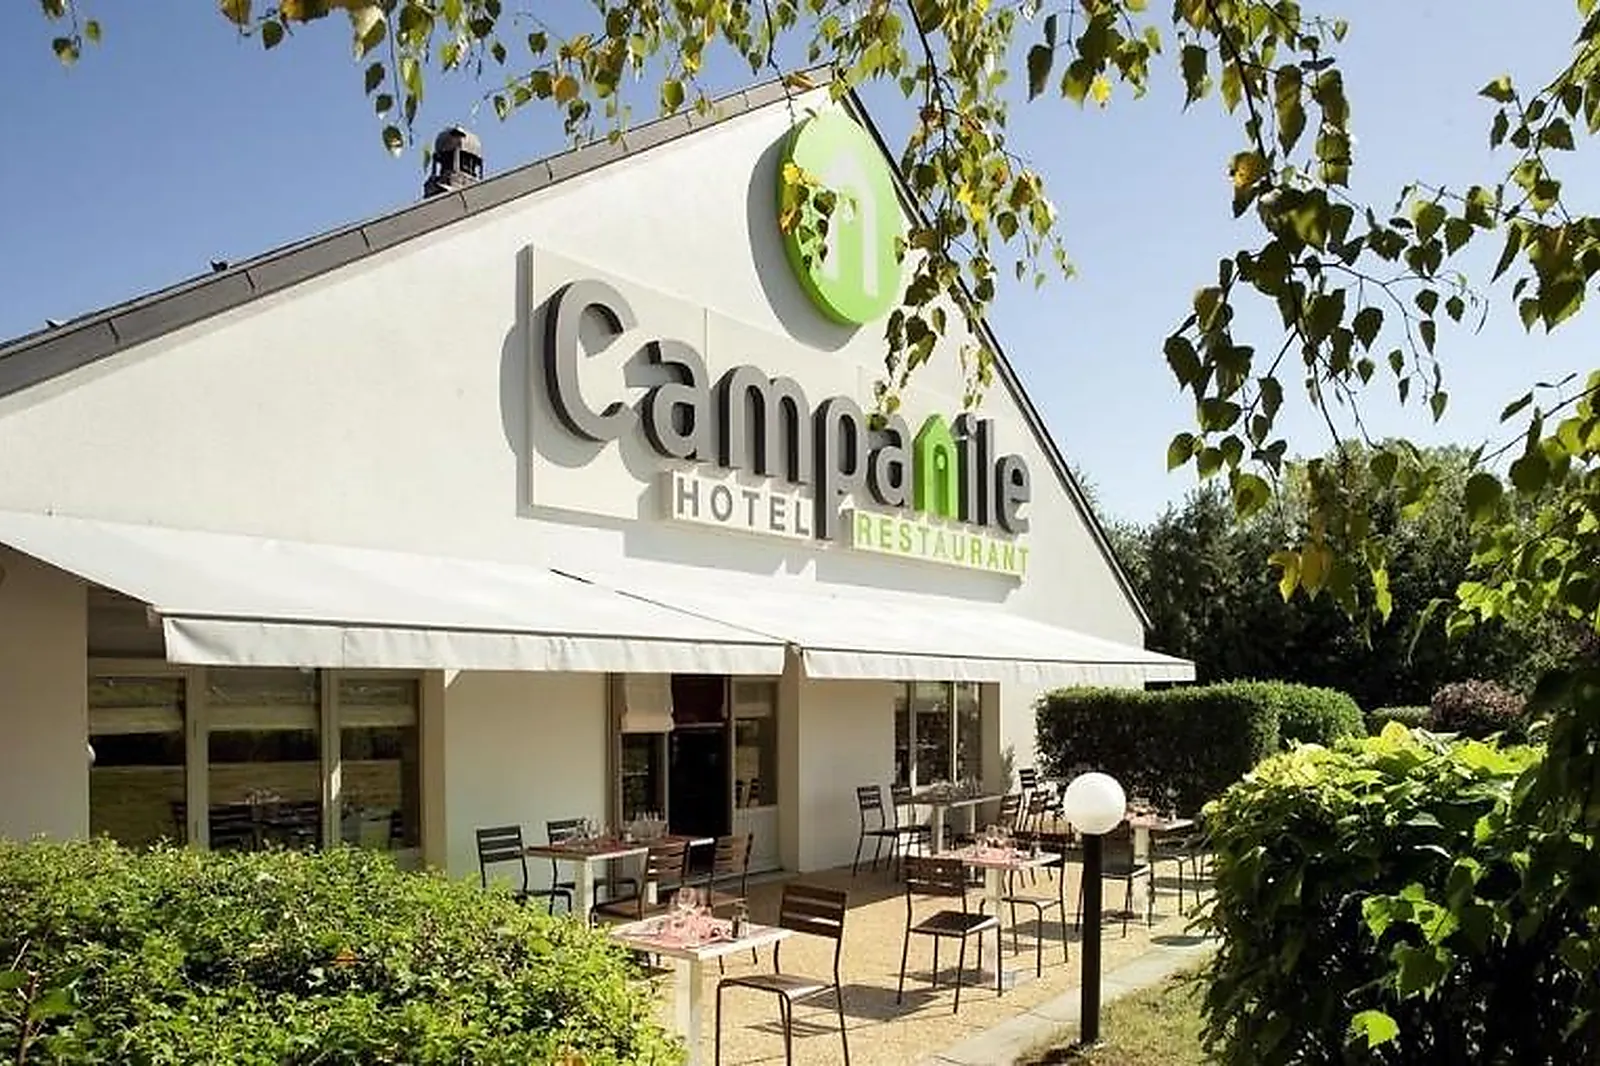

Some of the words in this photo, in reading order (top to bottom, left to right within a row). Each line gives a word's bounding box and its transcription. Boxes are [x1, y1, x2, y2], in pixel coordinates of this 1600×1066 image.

[545, 279, 1031, 539] Campanile
[677, 477, 811, 535] HOTEL
[857, 513, 1029, 573] RESTAURANT
